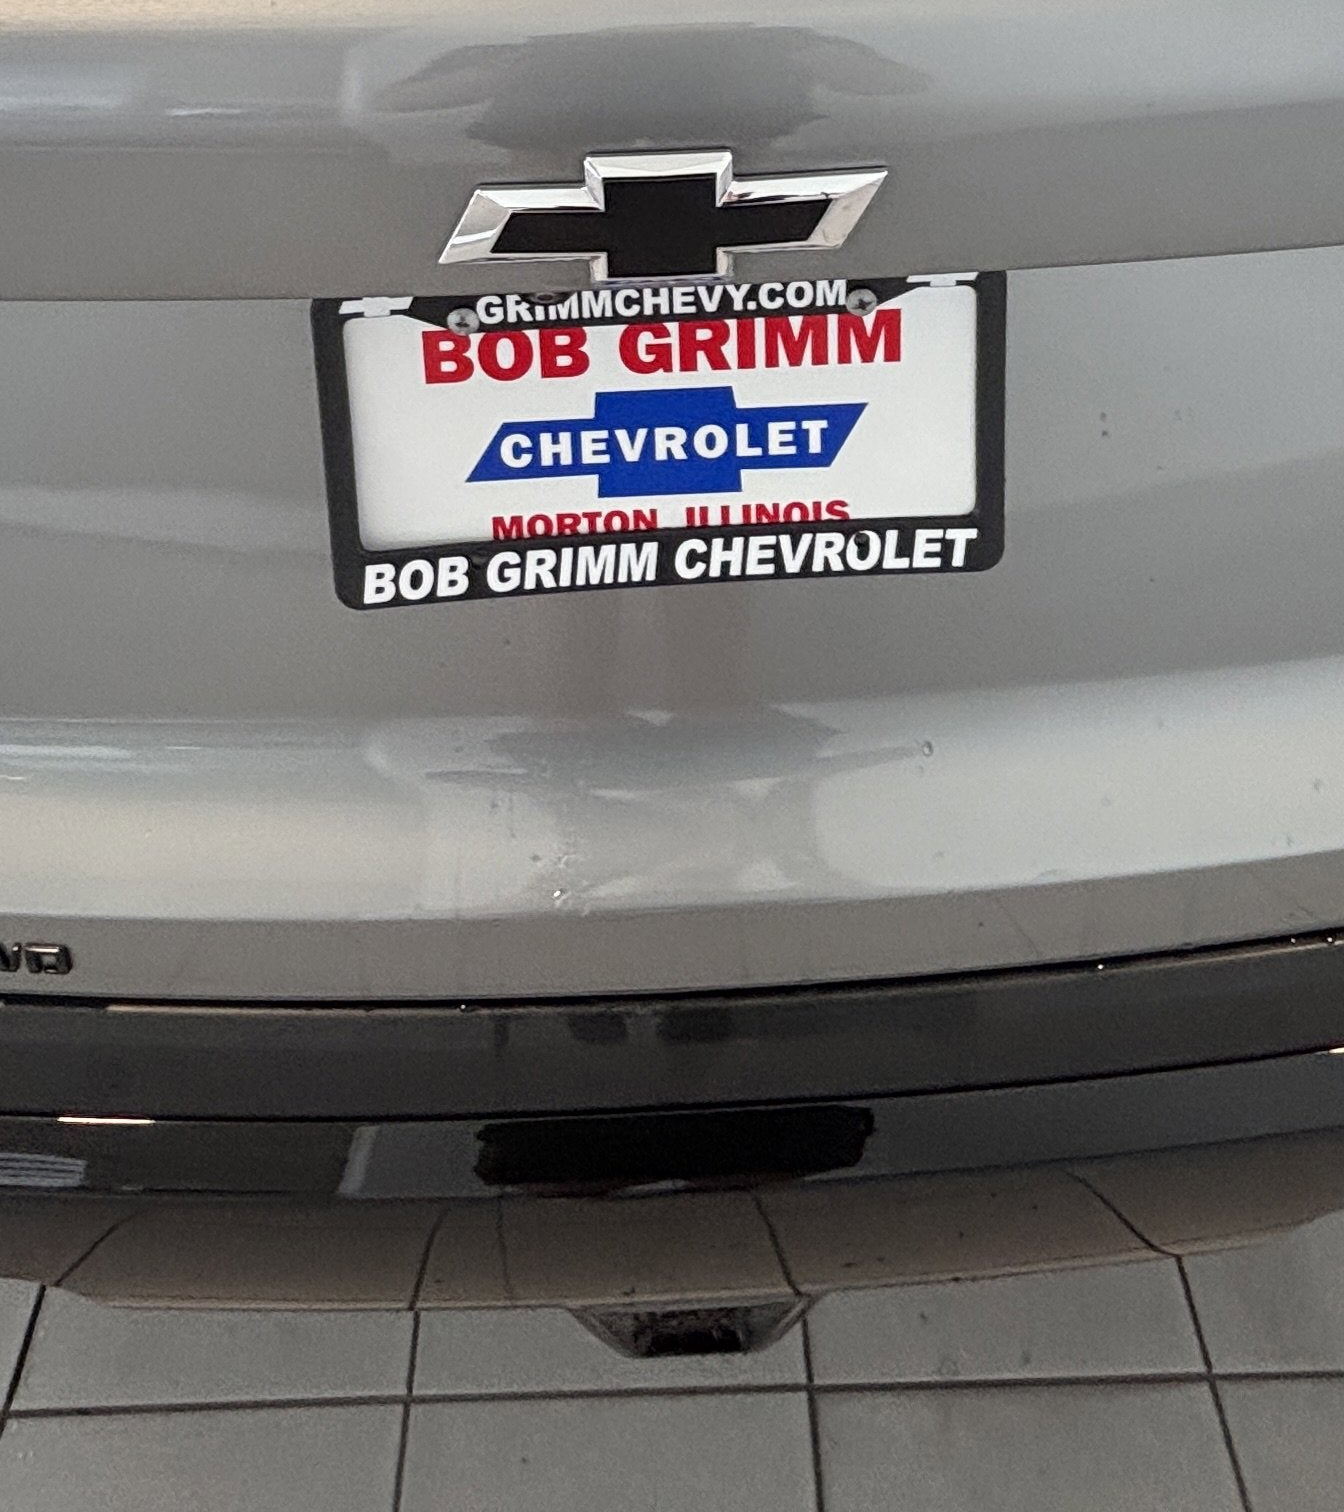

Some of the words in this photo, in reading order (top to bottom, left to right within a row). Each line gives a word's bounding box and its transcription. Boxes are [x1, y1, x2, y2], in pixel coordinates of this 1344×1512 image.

[476, 279, 847, 326] GRIMMCHEVY.COM
[422, 326, 590, 385] BOB
[619, 309, 902, 375] GRIMM
[500, 419, 828, 468] CHEVROLET
[491, 508, 657, 540] MORTON
[362, 555, 469, 605] BOB
[487, 541, 657, 591] GRIMM
[674, 529, 978, 578] CHEVROLET
